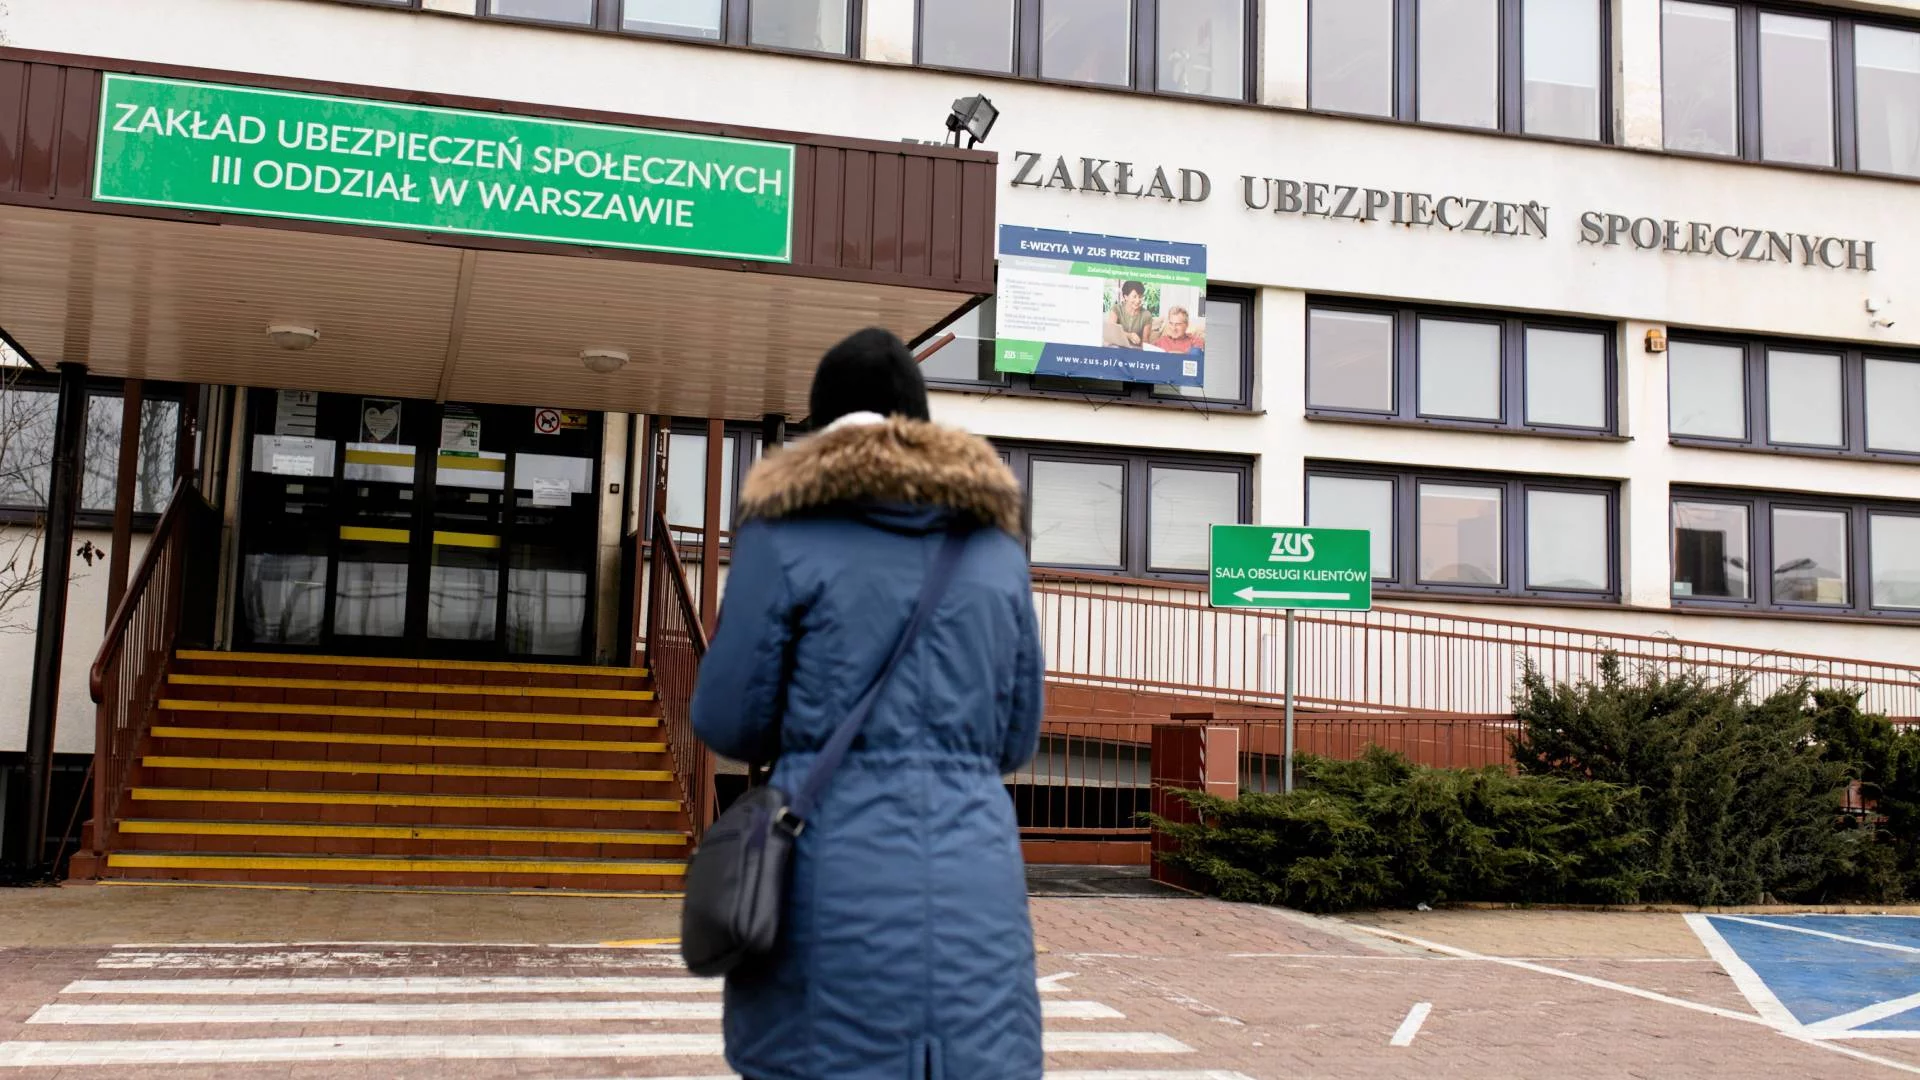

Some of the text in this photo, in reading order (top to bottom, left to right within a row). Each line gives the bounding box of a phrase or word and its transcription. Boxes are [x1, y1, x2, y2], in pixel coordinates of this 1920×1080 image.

[113, 103, 783, 196] ZAKŁAD UBEZPIECZEŃ SPOŁECZNYCH
[211, 155, 695, 228] III ODDZIAŁ W WARSZAWIE
[1010, 150, 1877, 272] ZAKŁAD UBEZPIECZEŃ SPOŁECZNYCH
[1020, 240, 1191, 265] E-WIZYTA W ZUS PRZEZ INTERNET
[1056, 355, 1160, 371] www.zus.pl/e-wizyta
[1268, 532, 1315, 562] ZUS
[1215, 567, 1367, 582] SALA OBSŁUGI KLIENTÓW
